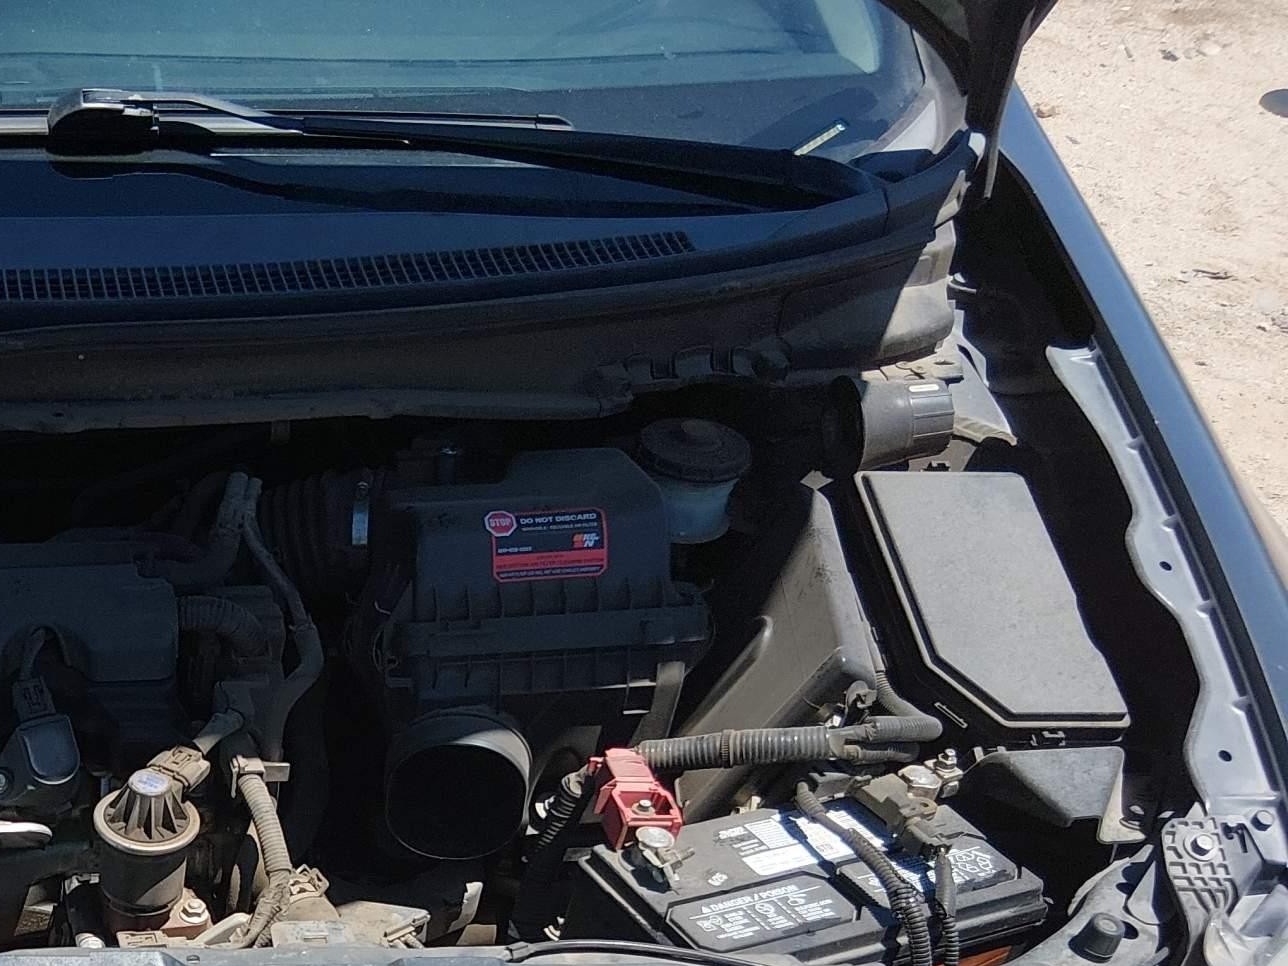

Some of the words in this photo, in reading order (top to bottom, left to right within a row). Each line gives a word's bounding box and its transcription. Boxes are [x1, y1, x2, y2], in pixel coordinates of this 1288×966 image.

[489, 518, 512, 528] STOP
[519, 517, 534, 525] DO
[534, 516, 554, 524] NOT
[555, 513, 597, 523] DISCARD
[711, 896, 754, 912] DANGER
[760, 884, 799, 899] POISON
